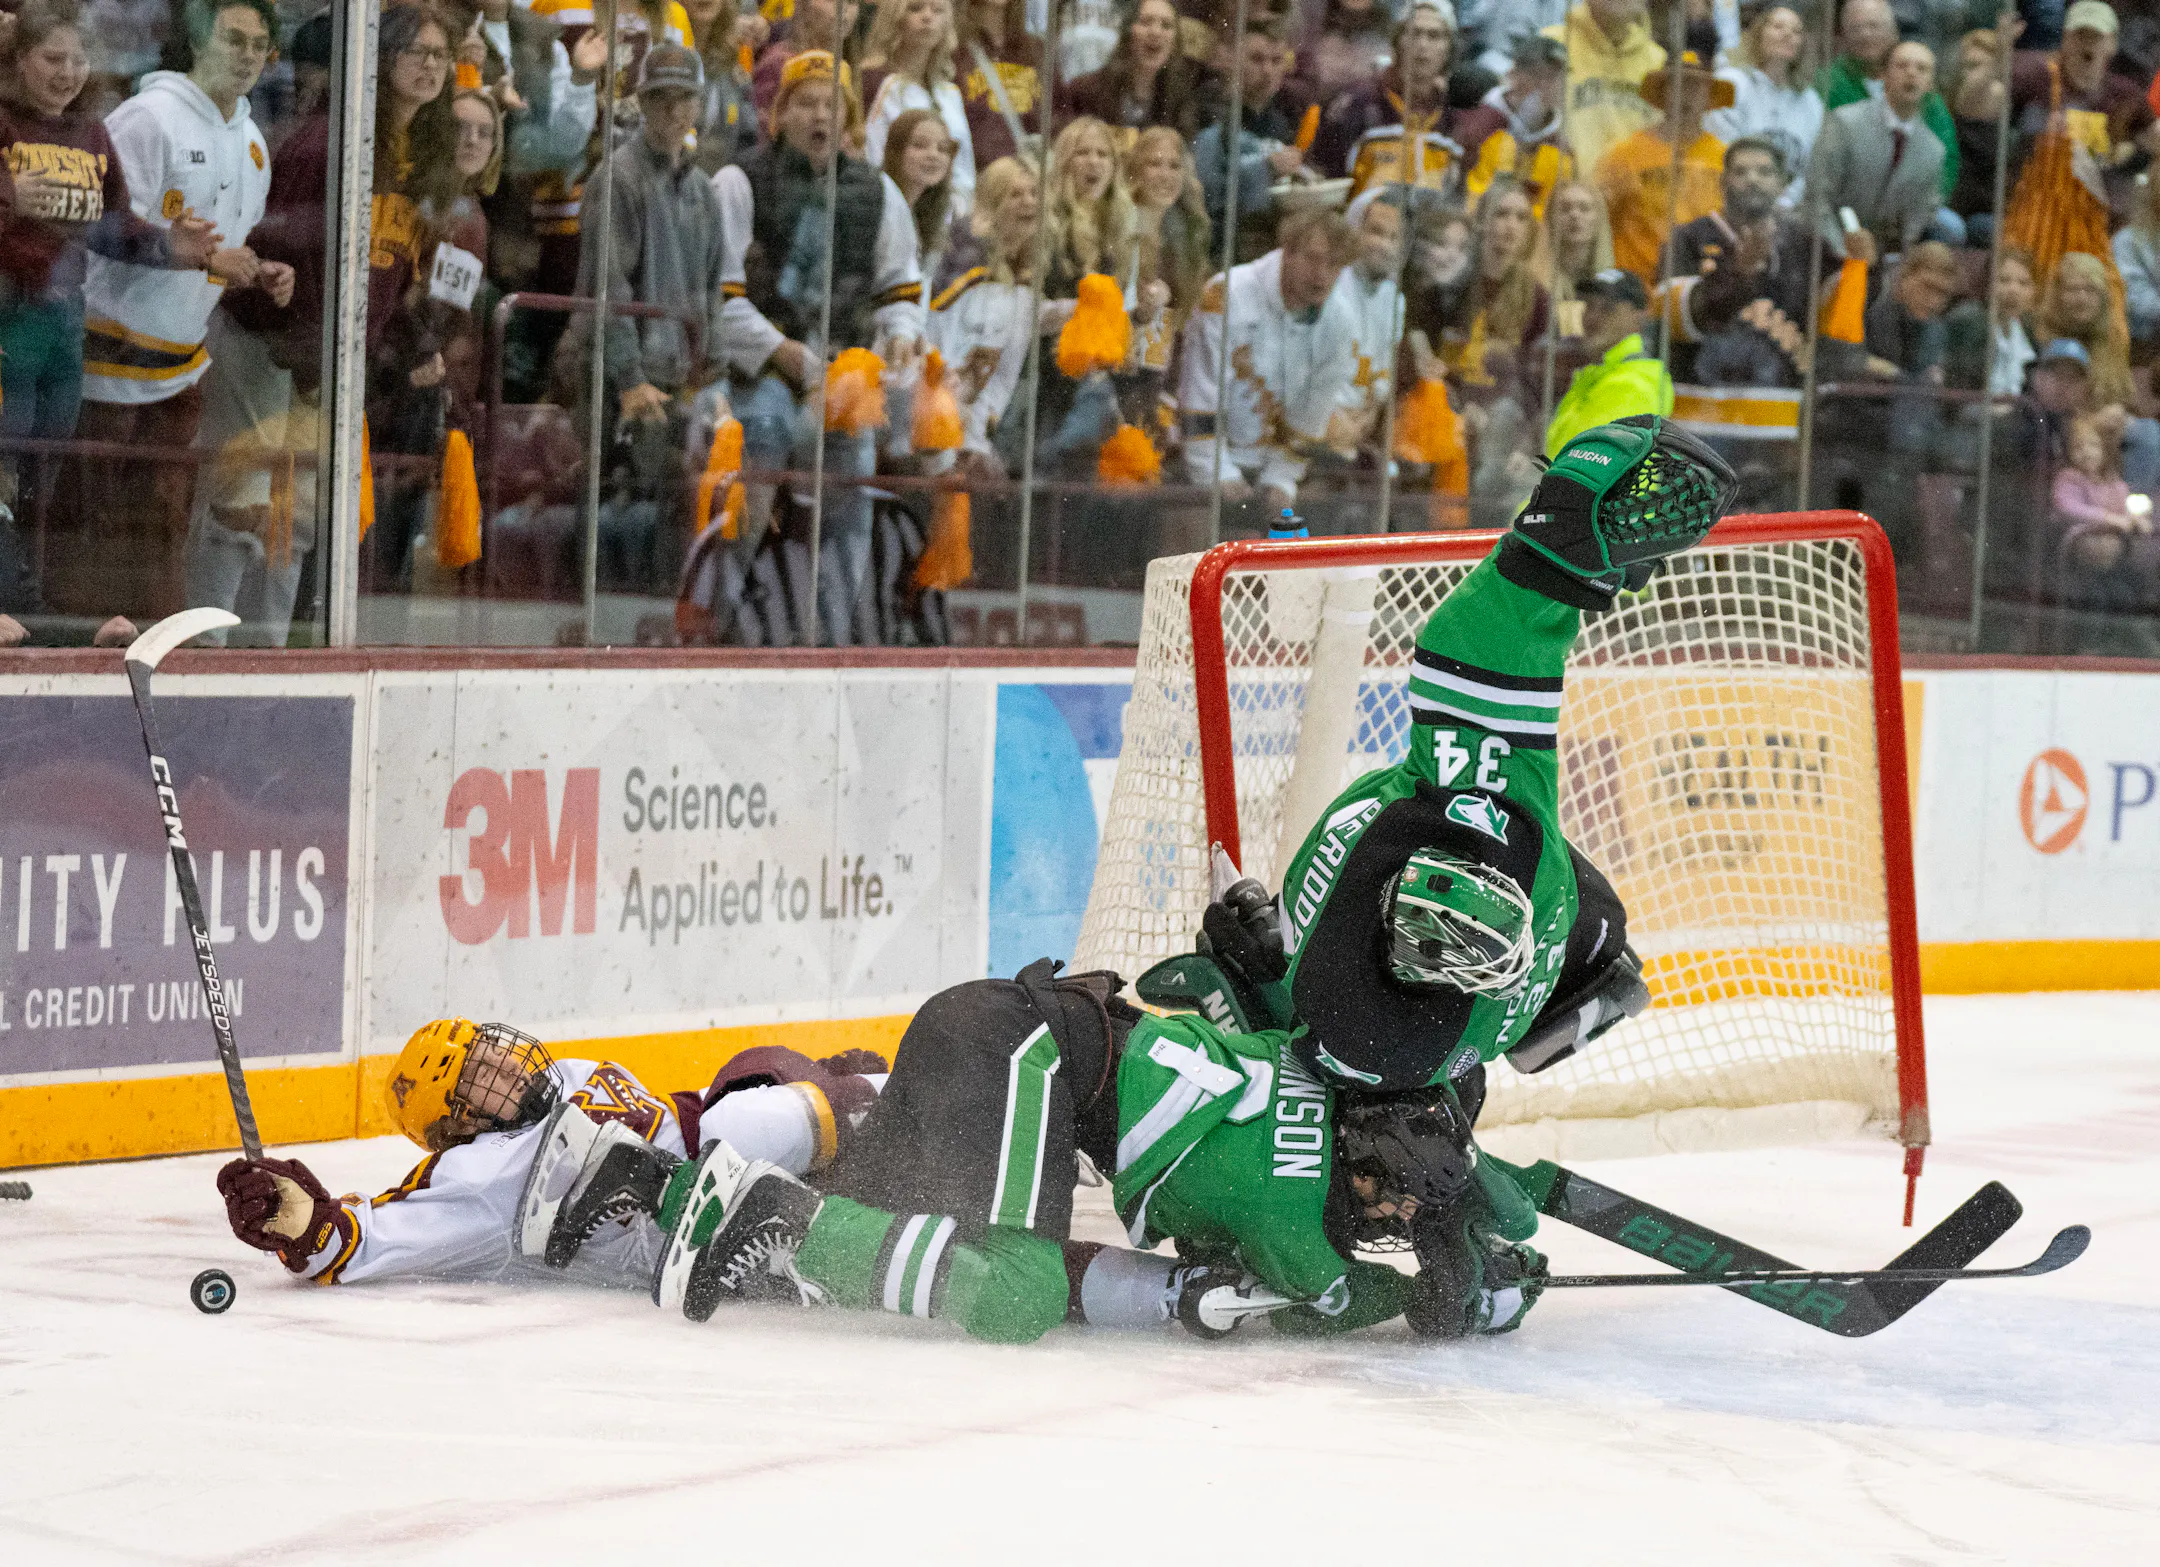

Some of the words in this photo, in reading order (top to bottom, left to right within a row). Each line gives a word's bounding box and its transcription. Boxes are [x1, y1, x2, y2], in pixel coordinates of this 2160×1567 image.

[1568, 448, 1613, 467] VAUGHN
[622, 765, 778, 833] Science.
[1433, 729, 1512, 794] 34
[150, 754, 188, 850] CCM
[439, 766, 600, 946] 3M
[619, 860, 764, 947] Applied
[773, 867, 810, 923] to
[25, 983, 136, 1030] CREDIT
[192, 924, 230, 1031] JETSPEED
